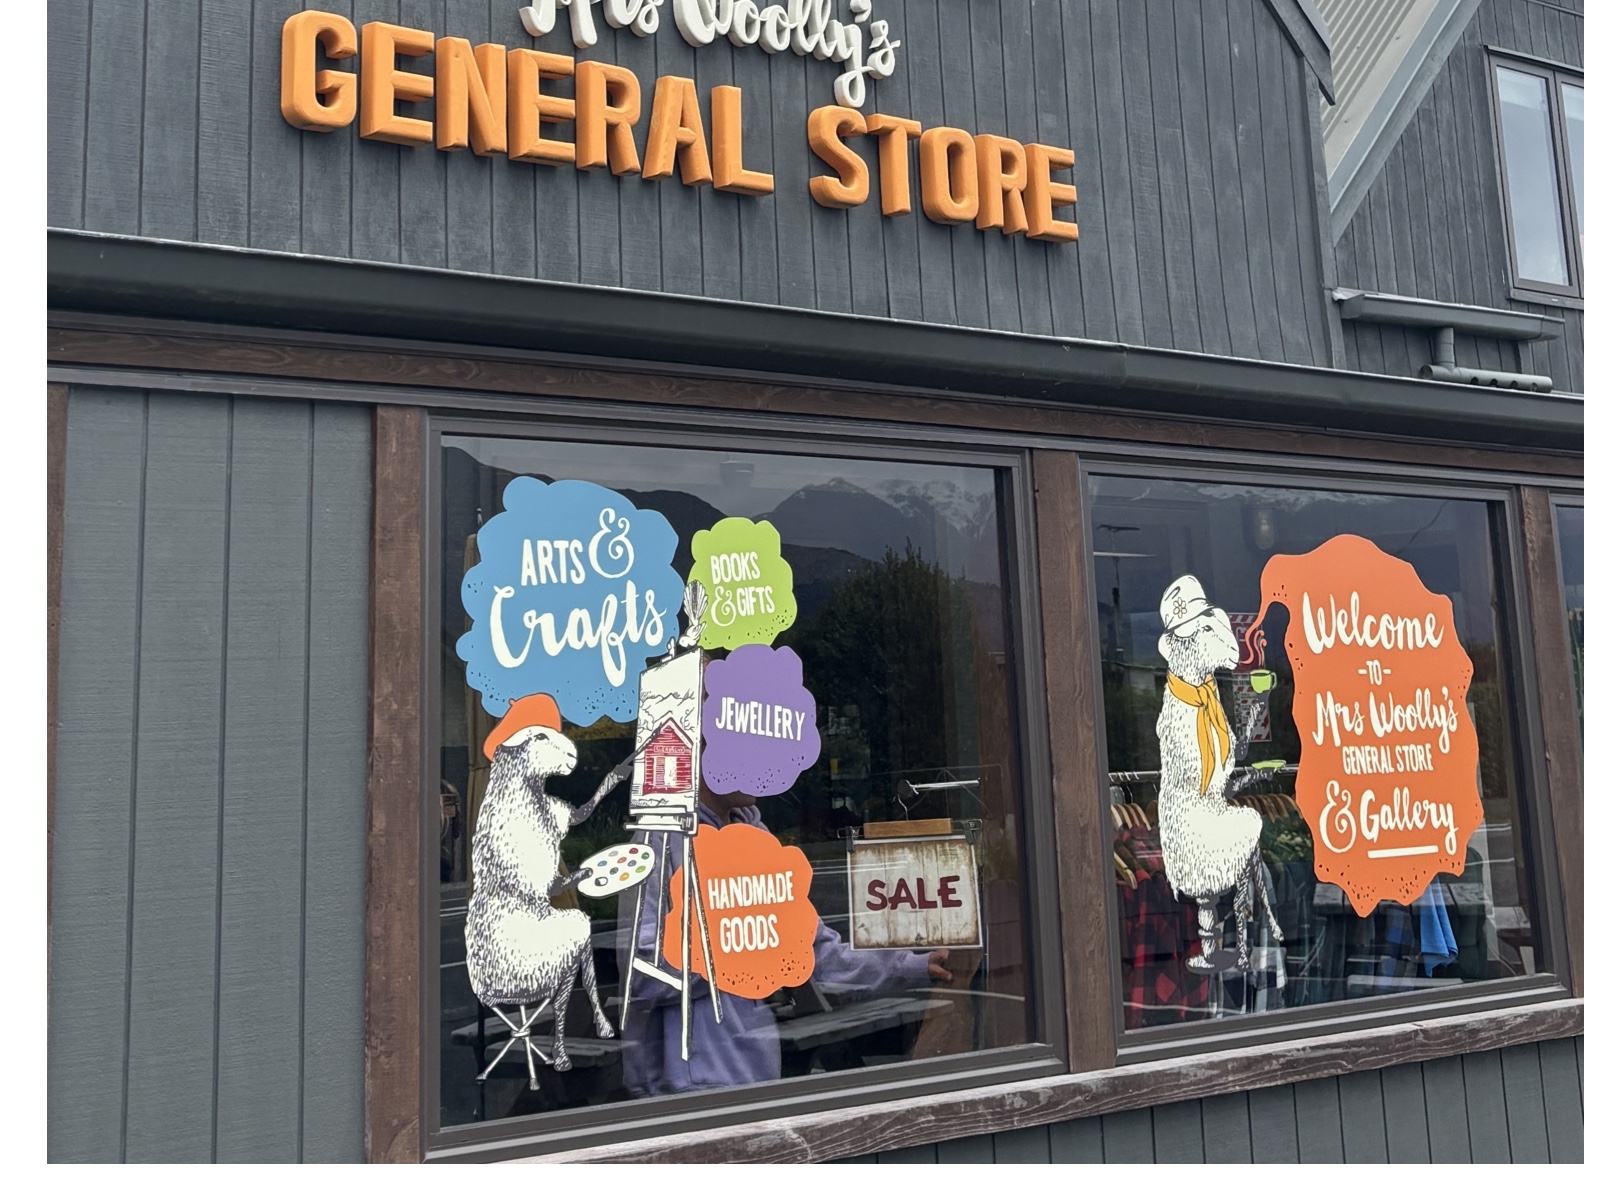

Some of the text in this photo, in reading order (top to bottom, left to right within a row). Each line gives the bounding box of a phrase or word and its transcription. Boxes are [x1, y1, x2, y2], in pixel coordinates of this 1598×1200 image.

[281, 9, 1079, 243] GENERAL STORE
[521, 508, 634, 586] ARTS &
[711, 552, 760, 584] BOOKS
[711, 586, 775, 626] & GIFTS
[1303, 591, 1444, 654] Welcome
[490, 580, 667, 687] Crafts
[715, 697, 805, 741] JEWELLERY
[1312, 691, 1365, 747] Mrs
[1369, 686, 1458, 754] Woolly's
[1342, 743, 1433, 775] GENERAL STORE
[1319, 780, 1459, 855] & Gallery
[708, 870, 794, 910] HANDMADE
[866, 875, 962, 911] SALE
[720, 914, 779, 953] GOODS
